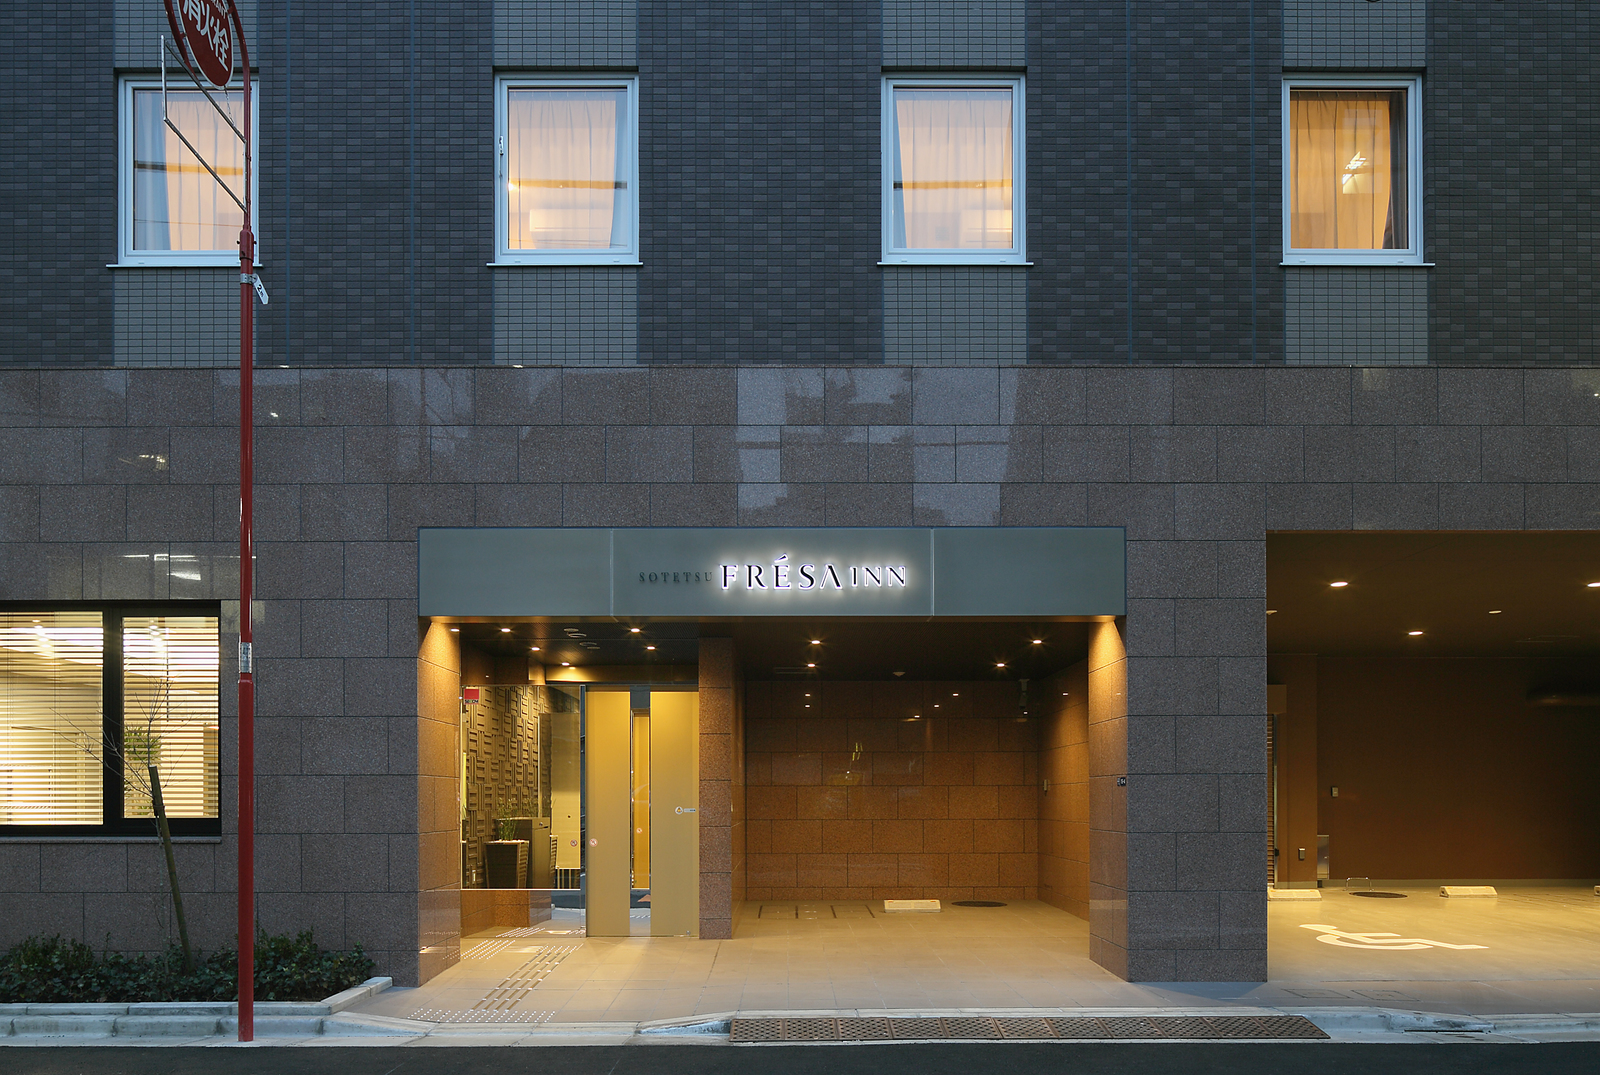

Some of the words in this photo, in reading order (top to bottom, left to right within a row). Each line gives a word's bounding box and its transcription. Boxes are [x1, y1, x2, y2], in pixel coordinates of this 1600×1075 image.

[638, 571, 713, 583] SOTETSU
[719, 552, 844, 590] FRÉSA
[849, 564, 907, 588] INN
